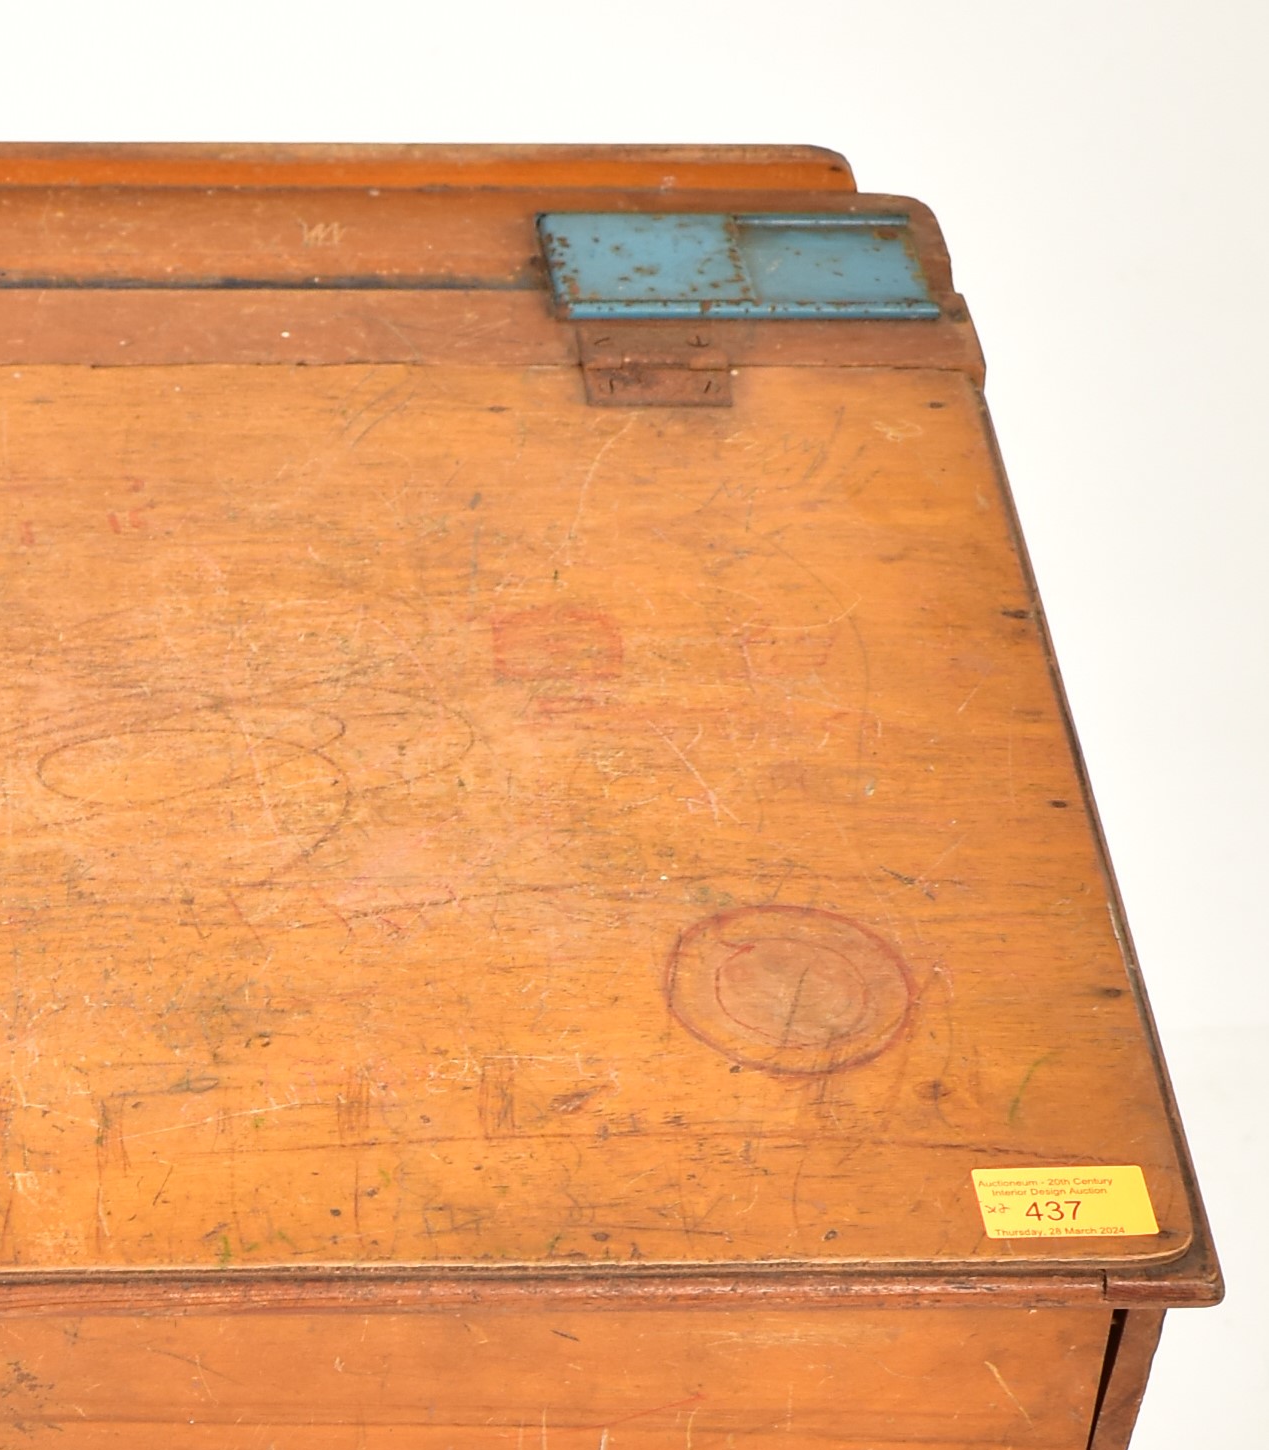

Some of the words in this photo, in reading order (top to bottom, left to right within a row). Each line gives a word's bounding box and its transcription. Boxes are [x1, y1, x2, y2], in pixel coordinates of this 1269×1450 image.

[1047, 1178, 1070, 1186] 20th
[1073, 1177, 1113, 1187] Century
[992, 1188, 1027, 1196] Interior
[1030, 1188, 1066, 1197] Design
[1069, 1187, 1107, 1195] Auction
[1025, 1201, 1082, 1221] 437
[1049, 1227, 1062, 1235] 28
[1064, 1227, 1097, 1235] March
[1099, 1226, 1125, 1234] 2024
